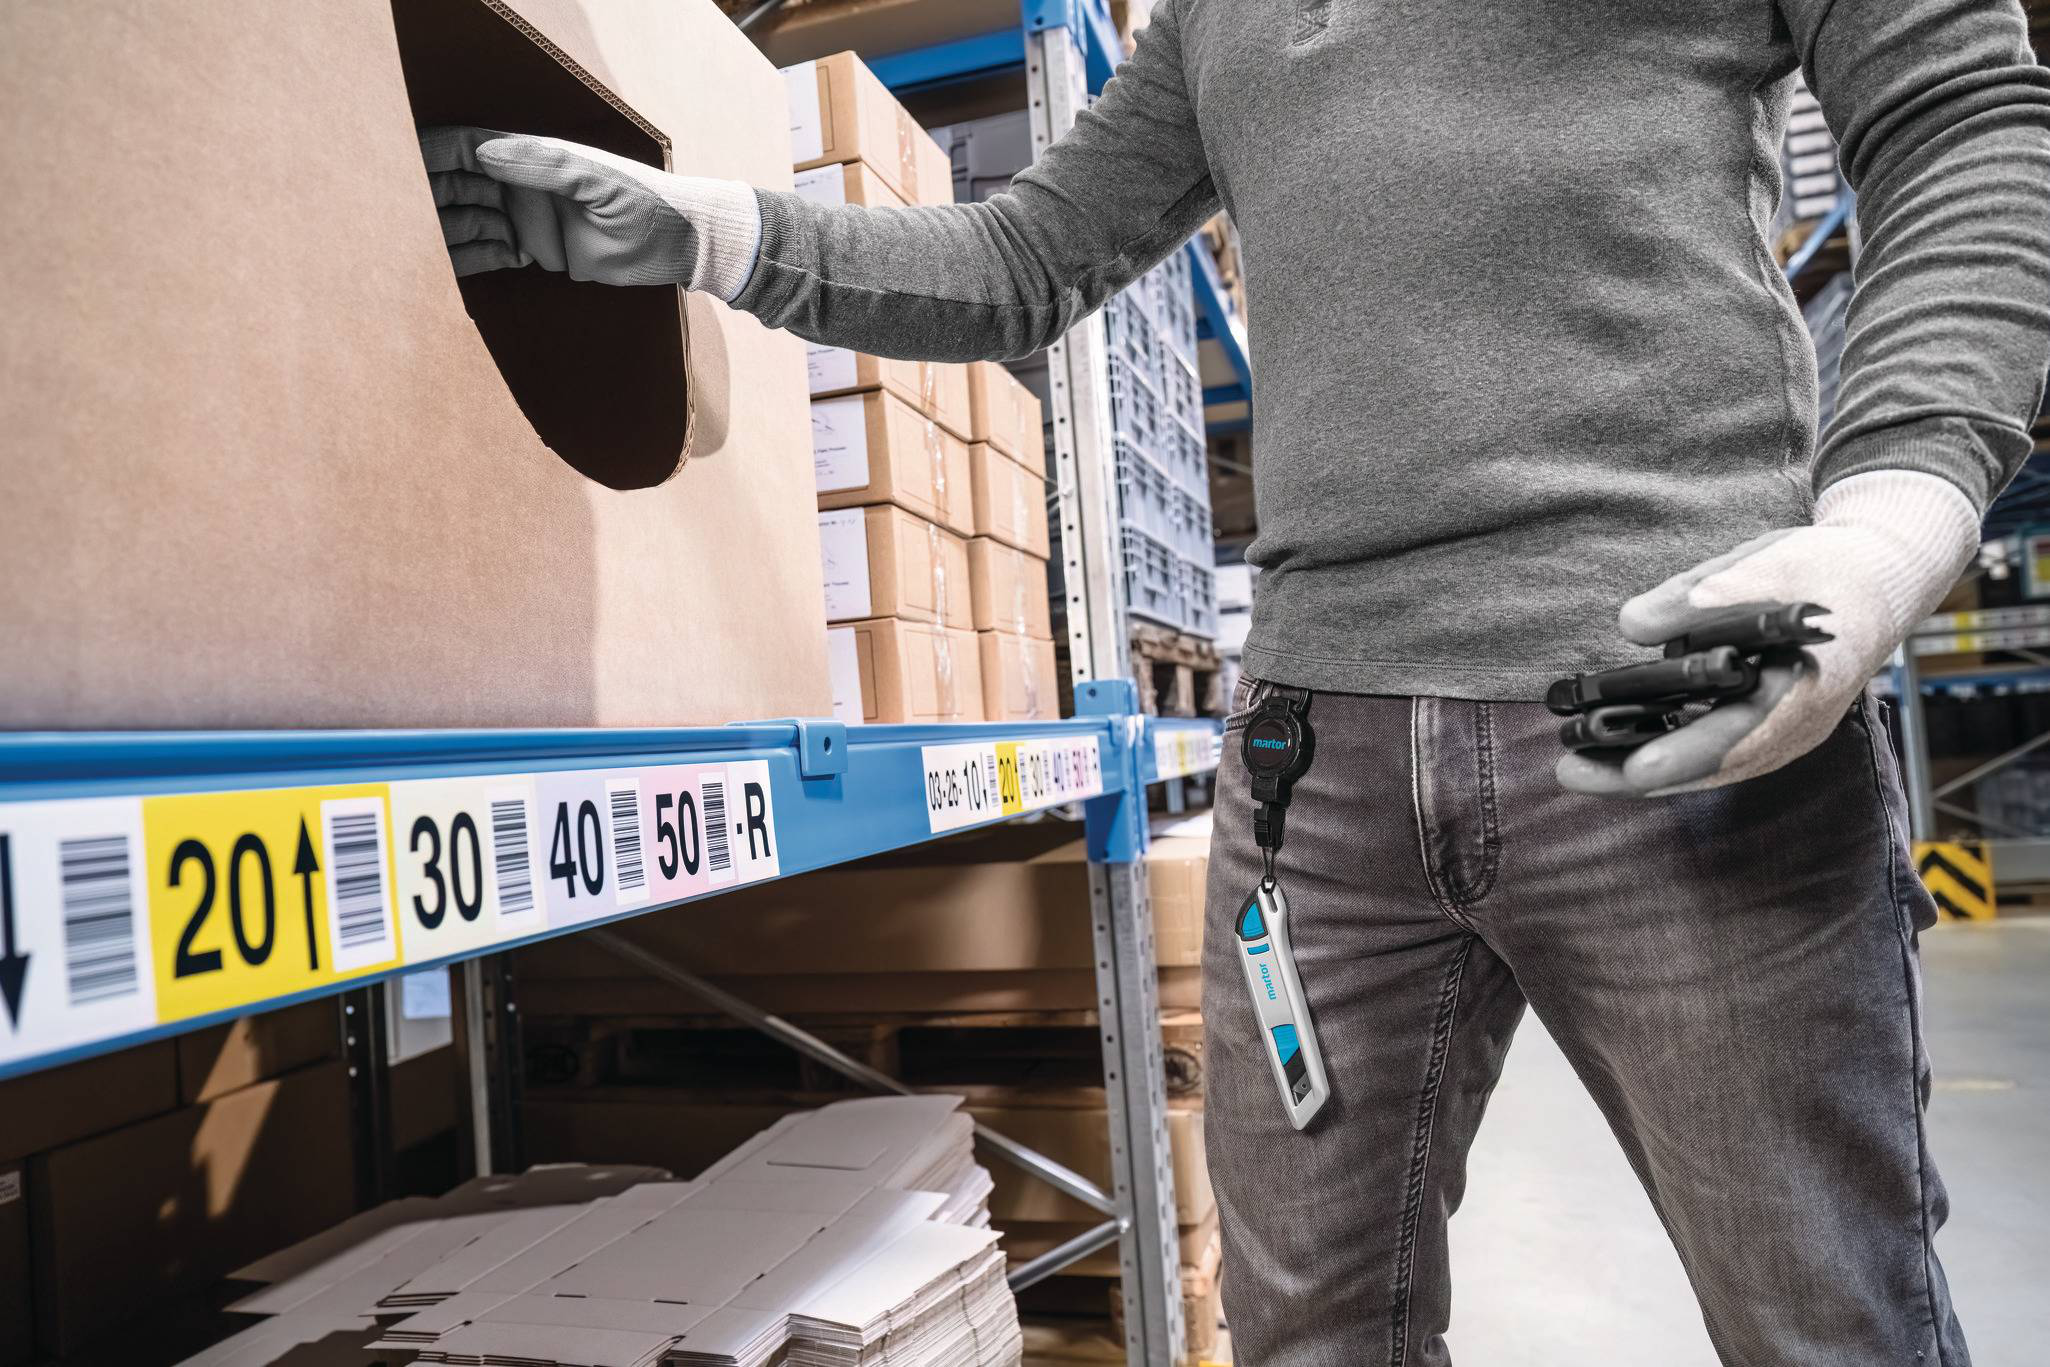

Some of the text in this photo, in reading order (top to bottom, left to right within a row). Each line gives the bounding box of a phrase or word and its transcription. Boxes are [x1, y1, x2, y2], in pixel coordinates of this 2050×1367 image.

[1252, 738, 1287, 750] martor
[999, 757, 1015, 803] 20
[168, 782, 772, 979] 20 30 40 50 -R
[1259, 963, 1277, 1000] martor
